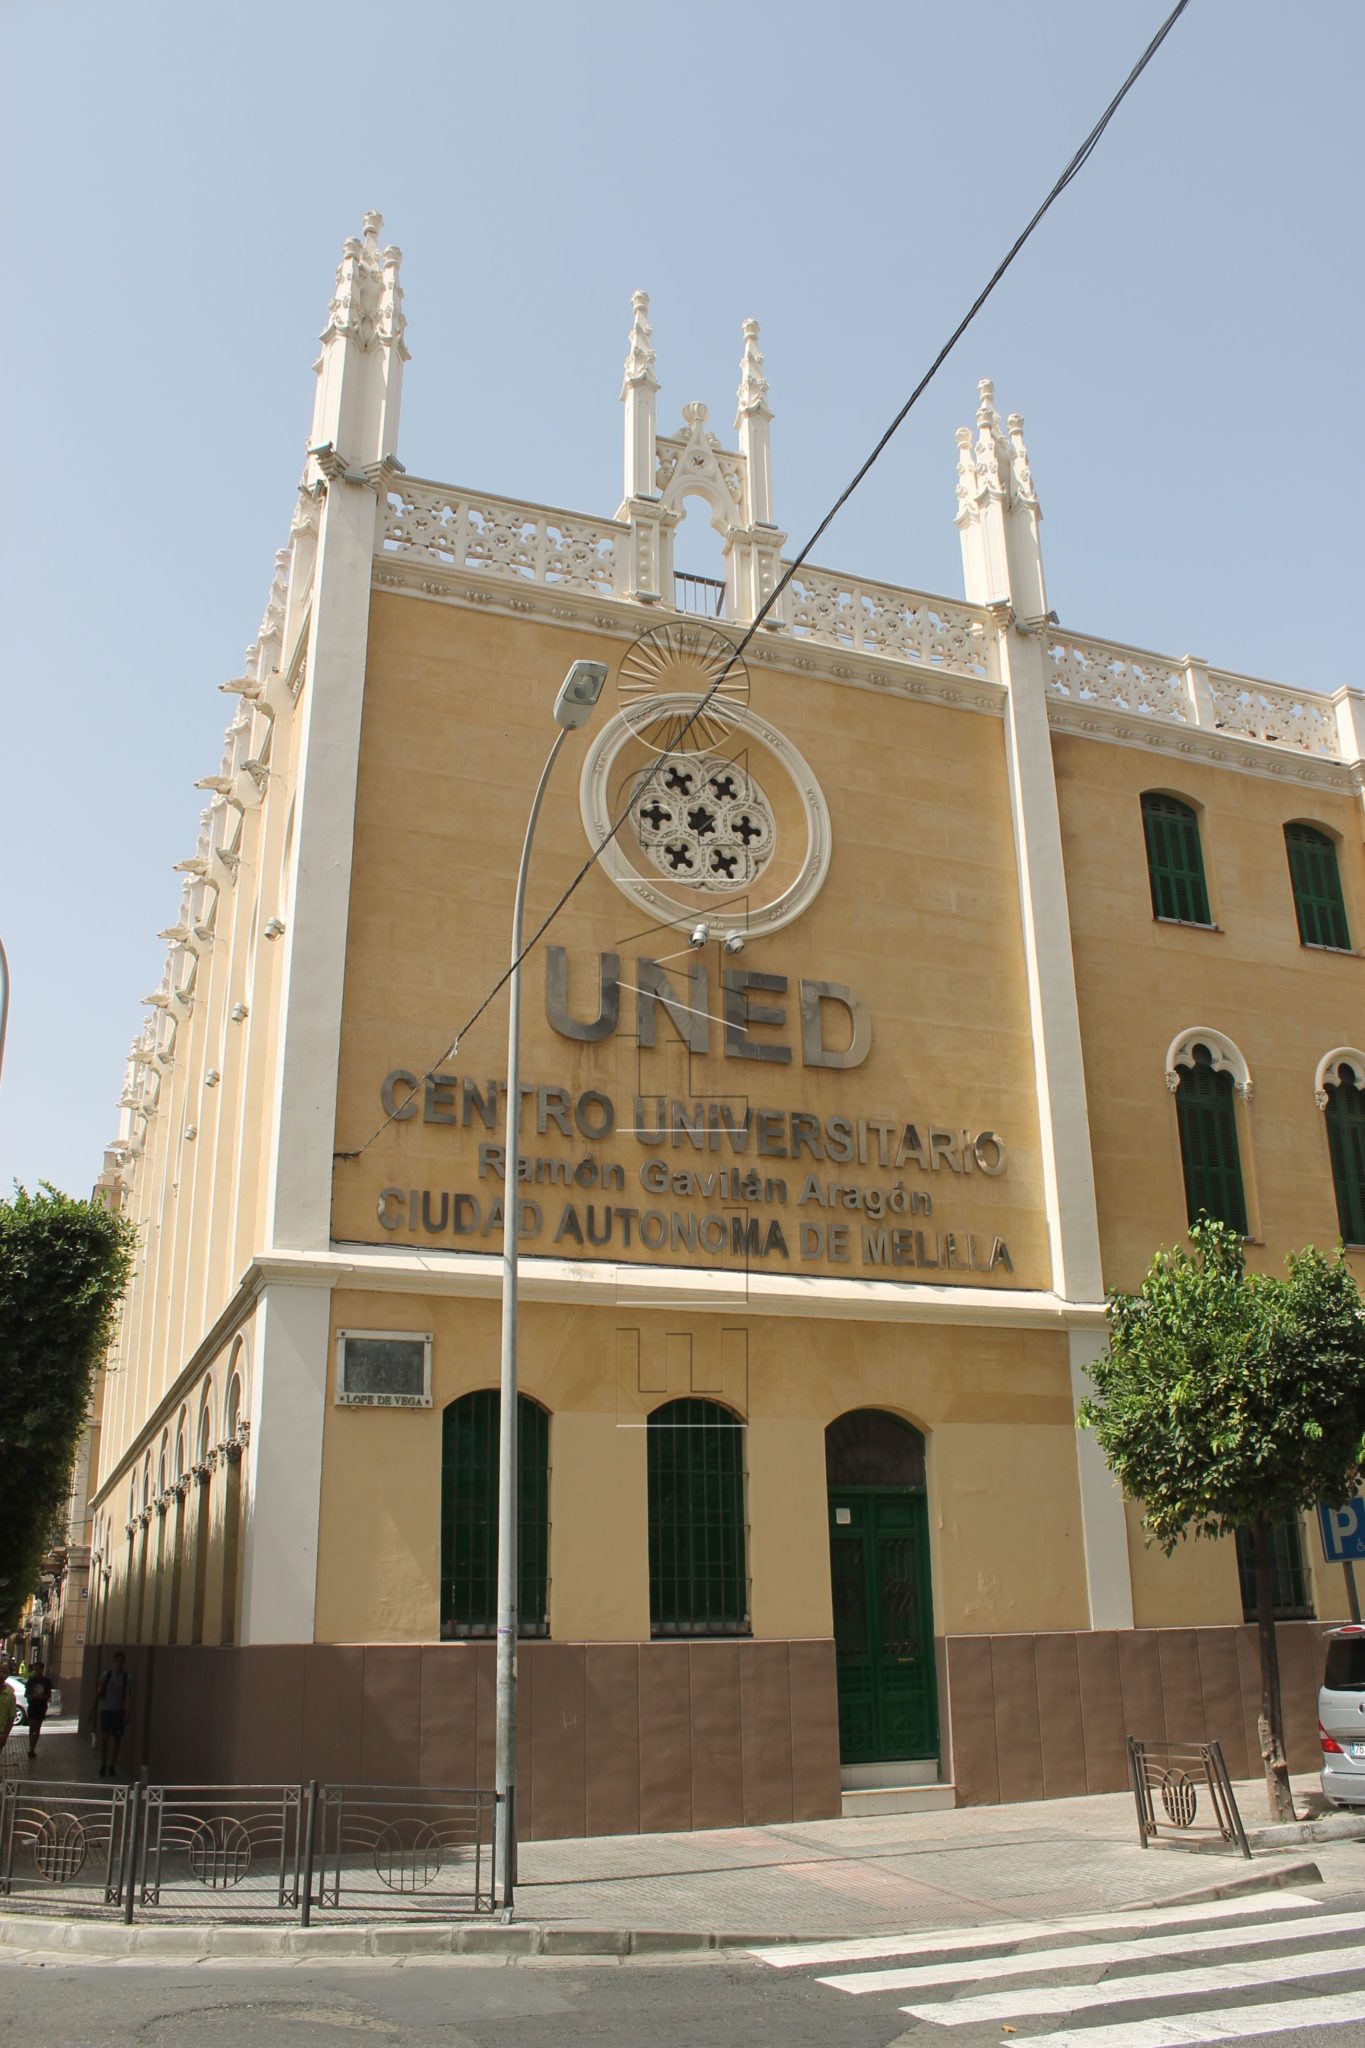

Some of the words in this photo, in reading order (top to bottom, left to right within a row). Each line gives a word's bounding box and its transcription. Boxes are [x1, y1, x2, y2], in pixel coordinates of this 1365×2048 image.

[545, 944, 872, 1069] UNED
[633, 1096, 1006, 1176] UNIVERSITARIO
[479, 1143, 625, 1191] Ramón
[639, 1158, 788, 1205] Gavilán
[798, 1173, 932, 1219] Aragón
[377, 1187, 543, 1240] CIUDAD
[554, 1204, 790, 1259] AUTONOMA
[800, 1222, 849, 1263] DE
[862, 1226, 1014, 1274] MELILLA
[346, 1394, 374, 1405] LOPE
[377, 1395, 392, 1406] DE
[392, 1396, 423, 1407] VEGA
[1328, 1505, 1359, 1554] P
